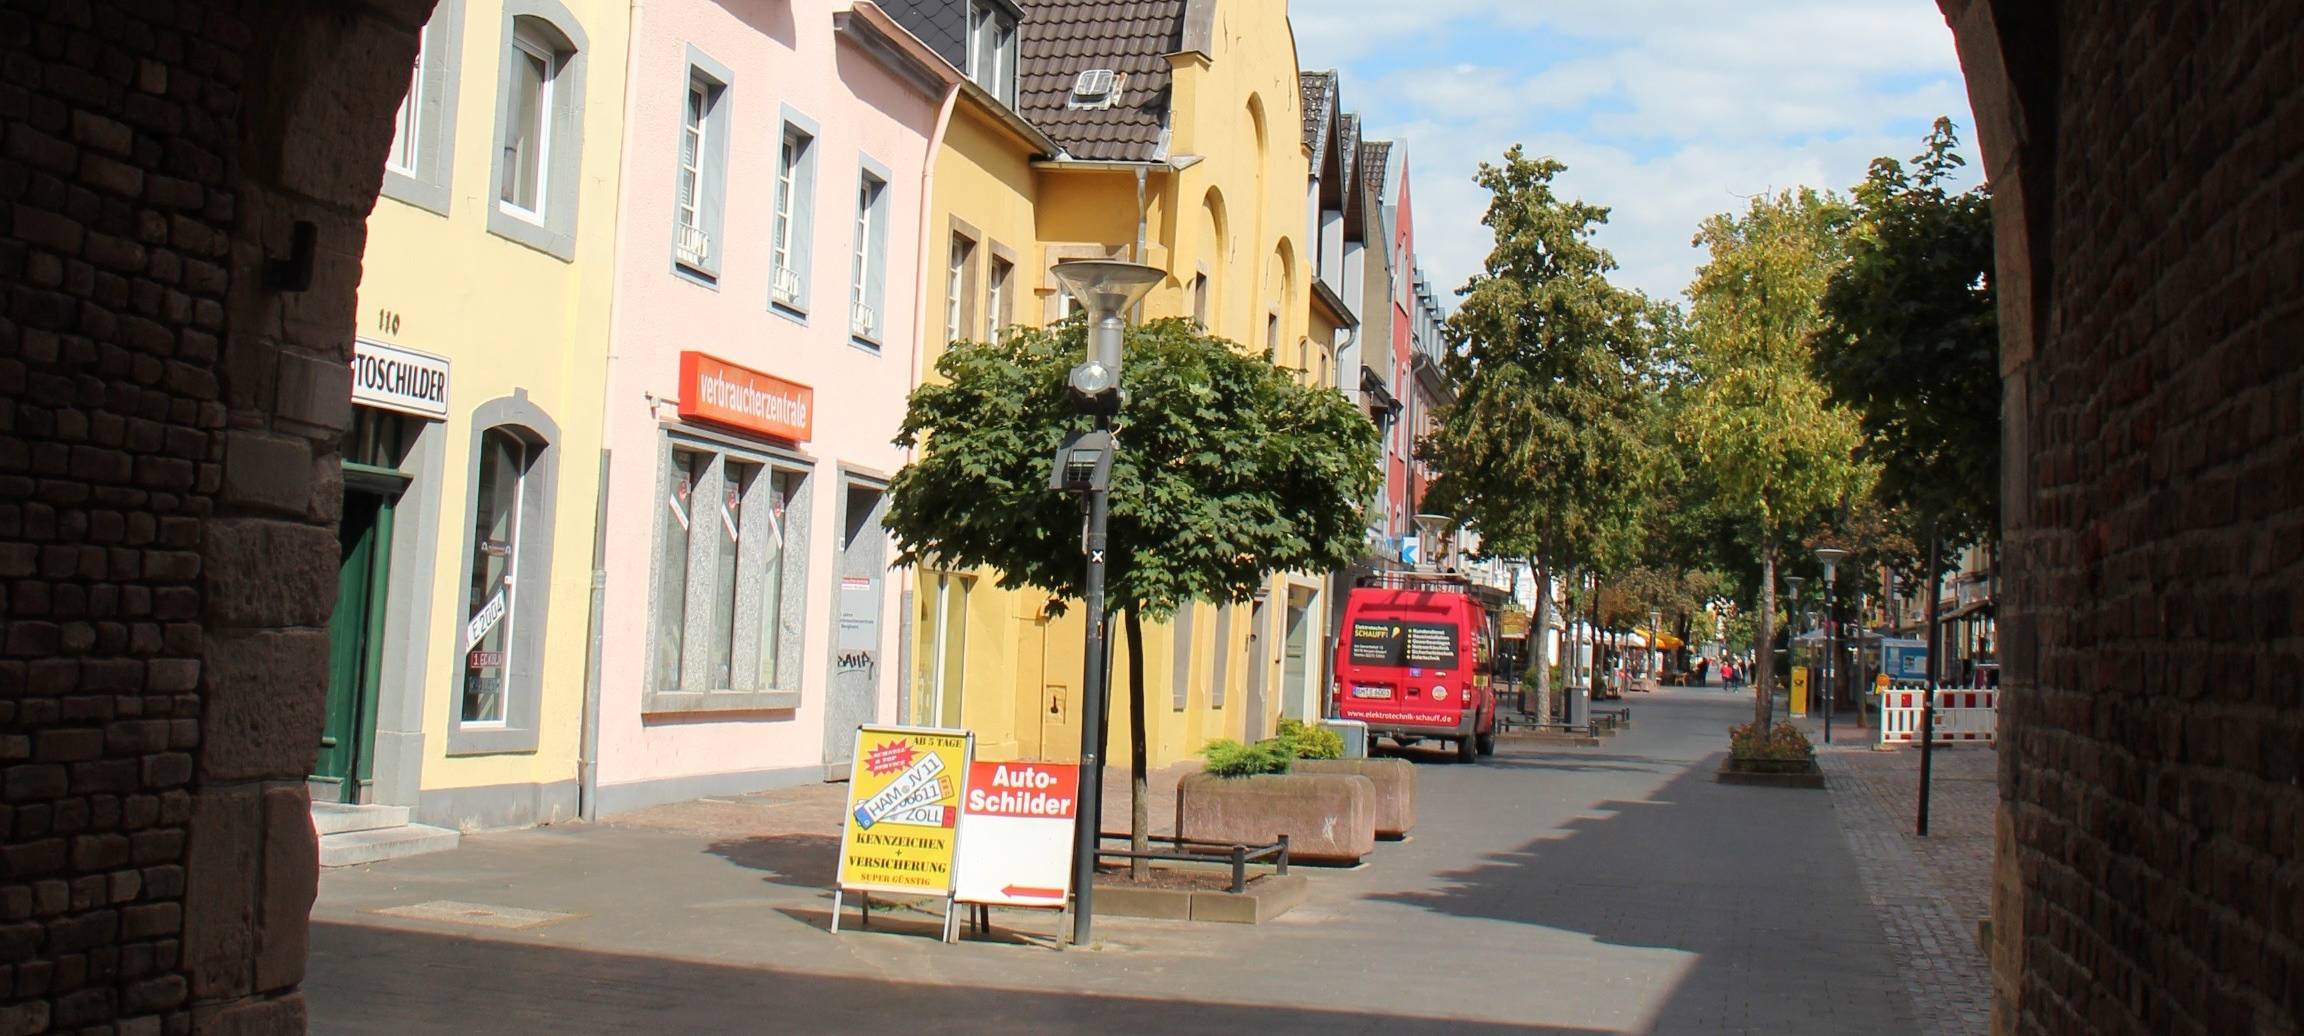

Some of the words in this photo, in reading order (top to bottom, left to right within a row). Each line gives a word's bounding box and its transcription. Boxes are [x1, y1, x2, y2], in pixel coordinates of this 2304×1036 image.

[378, 308, 401, 336] 110
[353, 353, 445, 403] TOSCHILDER
[700, 367, 807, 429] verbraucherzentrale
[1346, 710, 1452, 723] www.elektrotechnik-schauff.de
[914, 737, 927, 746] AB
[929, 738, 935, 746] 5
[937, 738, 962, 748] TAGE
[869, 786, 902, 817] HAM
[922, 758, 940, 775] 11
[992, 765, 1058, 789] Auto-
[969, 789, 1072, 816] Schilder
[905, 808, 941, 823] ZOLL
[856, 833, 946, 850] KENNZEICHEN
[849, 856, 947, 874] VERSICHERUNG
[861, 873, 890, 884] SUPER
[892, 874, 930, 886] GÜNSTIG
